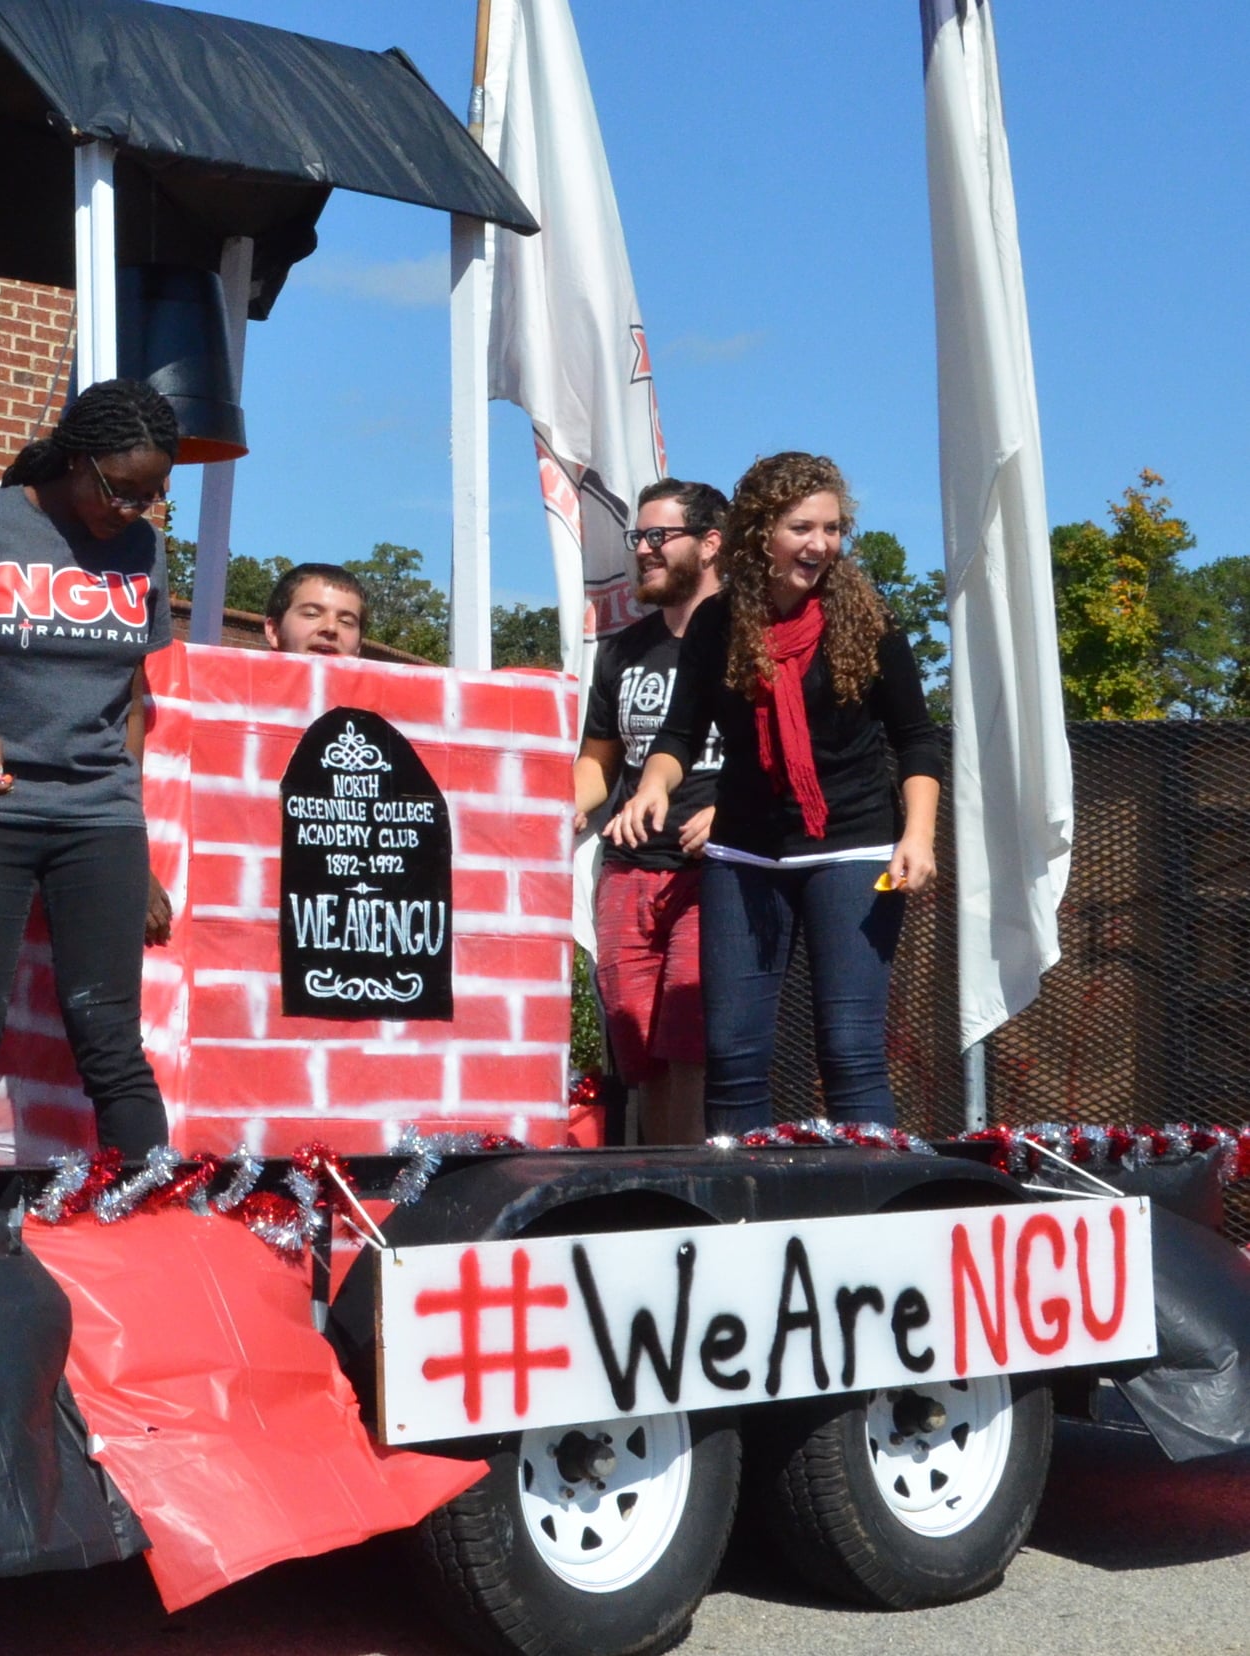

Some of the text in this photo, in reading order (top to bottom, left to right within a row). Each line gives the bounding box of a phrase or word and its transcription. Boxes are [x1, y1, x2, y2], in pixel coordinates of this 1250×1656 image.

[333, 775, 379, 798] NORTH
[287, 796, 434, 824] GREENVILLE COLLEGE
[297, 824, 419, 848] ACADEMY CLUB
[325, 854, 405, 876] 1892-1992
[289, 893, 340, 950] WE
